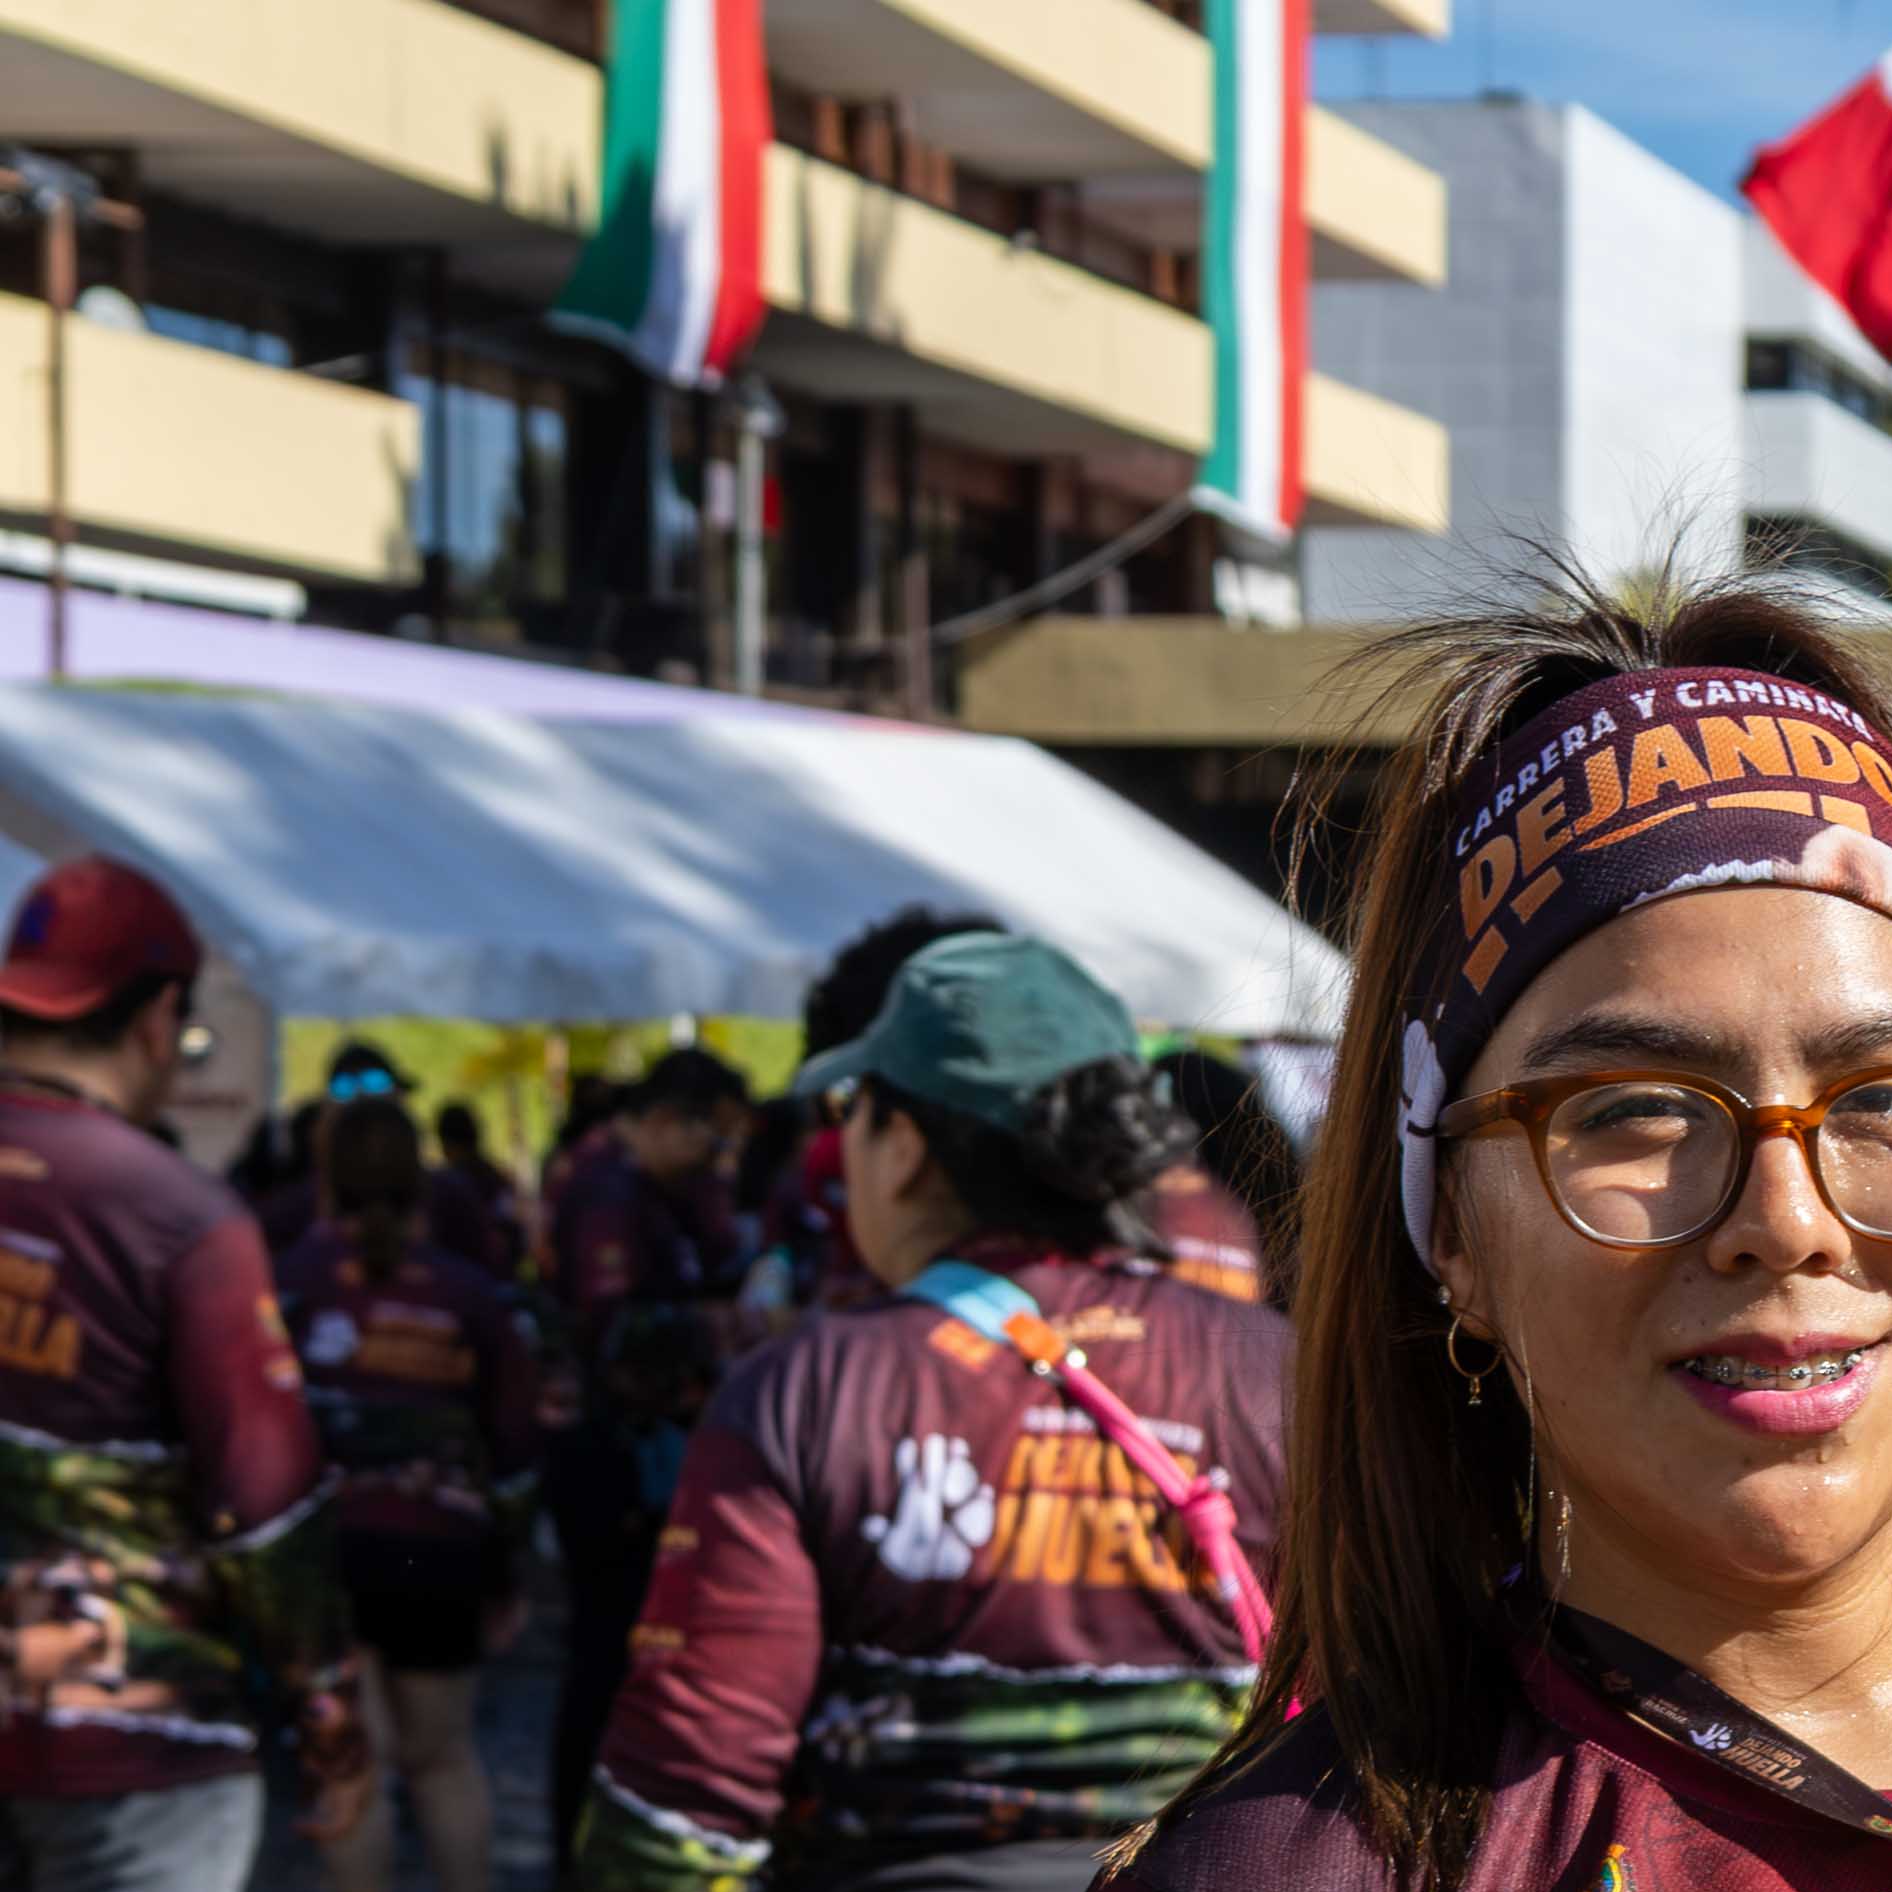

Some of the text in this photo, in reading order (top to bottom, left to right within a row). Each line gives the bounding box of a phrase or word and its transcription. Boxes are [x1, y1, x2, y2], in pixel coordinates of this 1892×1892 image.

[1455, 679, 1873, 857] CARRERA Y CAMINATA
[1719, 1744, 1806, 1791] HUELLA
[1741, 1737, 1802, 1769] DEJANDO
